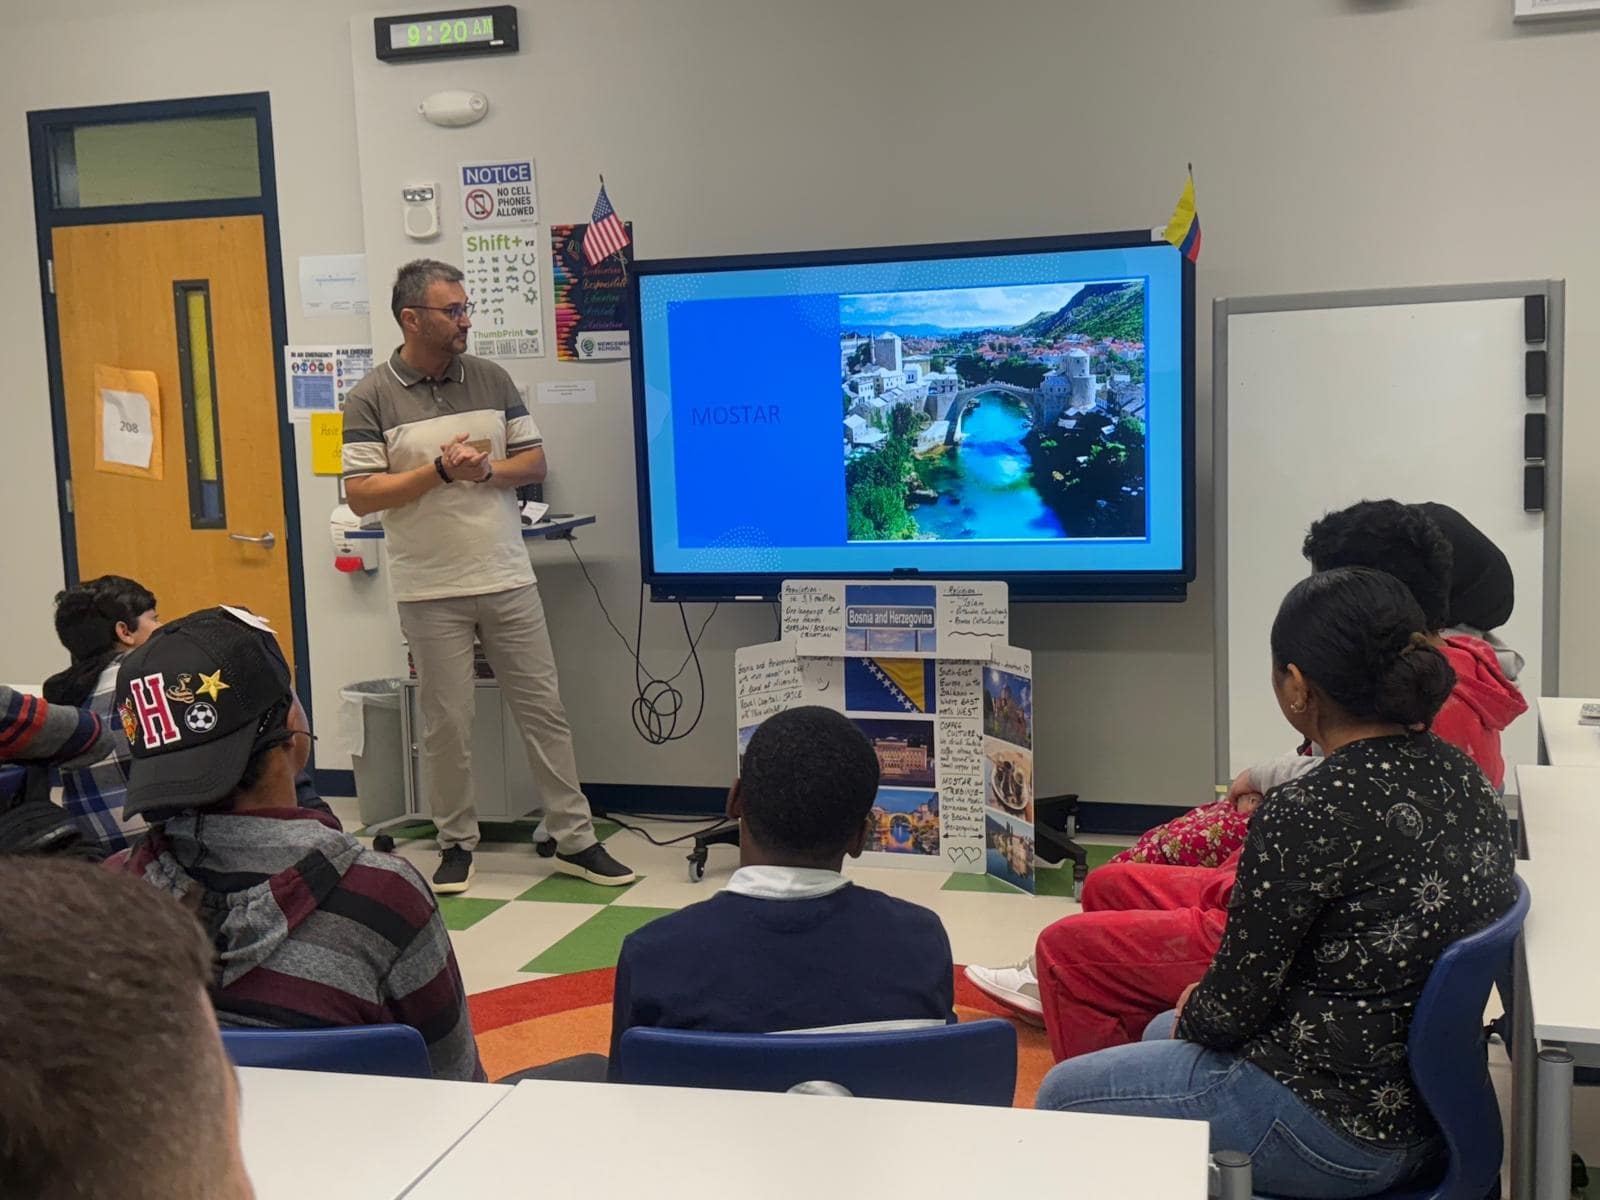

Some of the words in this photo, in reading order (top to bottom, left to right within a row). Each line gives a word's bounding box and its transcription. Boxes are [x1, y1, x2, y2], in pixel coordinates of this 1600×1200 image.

[473, 17, 492, 34] AM
[466, 165, 529, 184] NOTICE
[497, 187, 509, 197] NO
[511, 186, 531, 196] CELL
[498, 197, 531, 207] PHONES
[496, 206, 535, 217] ALLOWED
[467, 234, 522, 252] Shift+
[473, 328, 523, 338] ThumbPrint
[692, 405, 781, 425] MOSTAR
[120, 420, 139, 434] 208
[849, 610, 873, 624] Bosnia
[874, 610, 888, 624] and
[889, 610, 932, 627] Herzegovina
[130, 673, 181, 749] H
